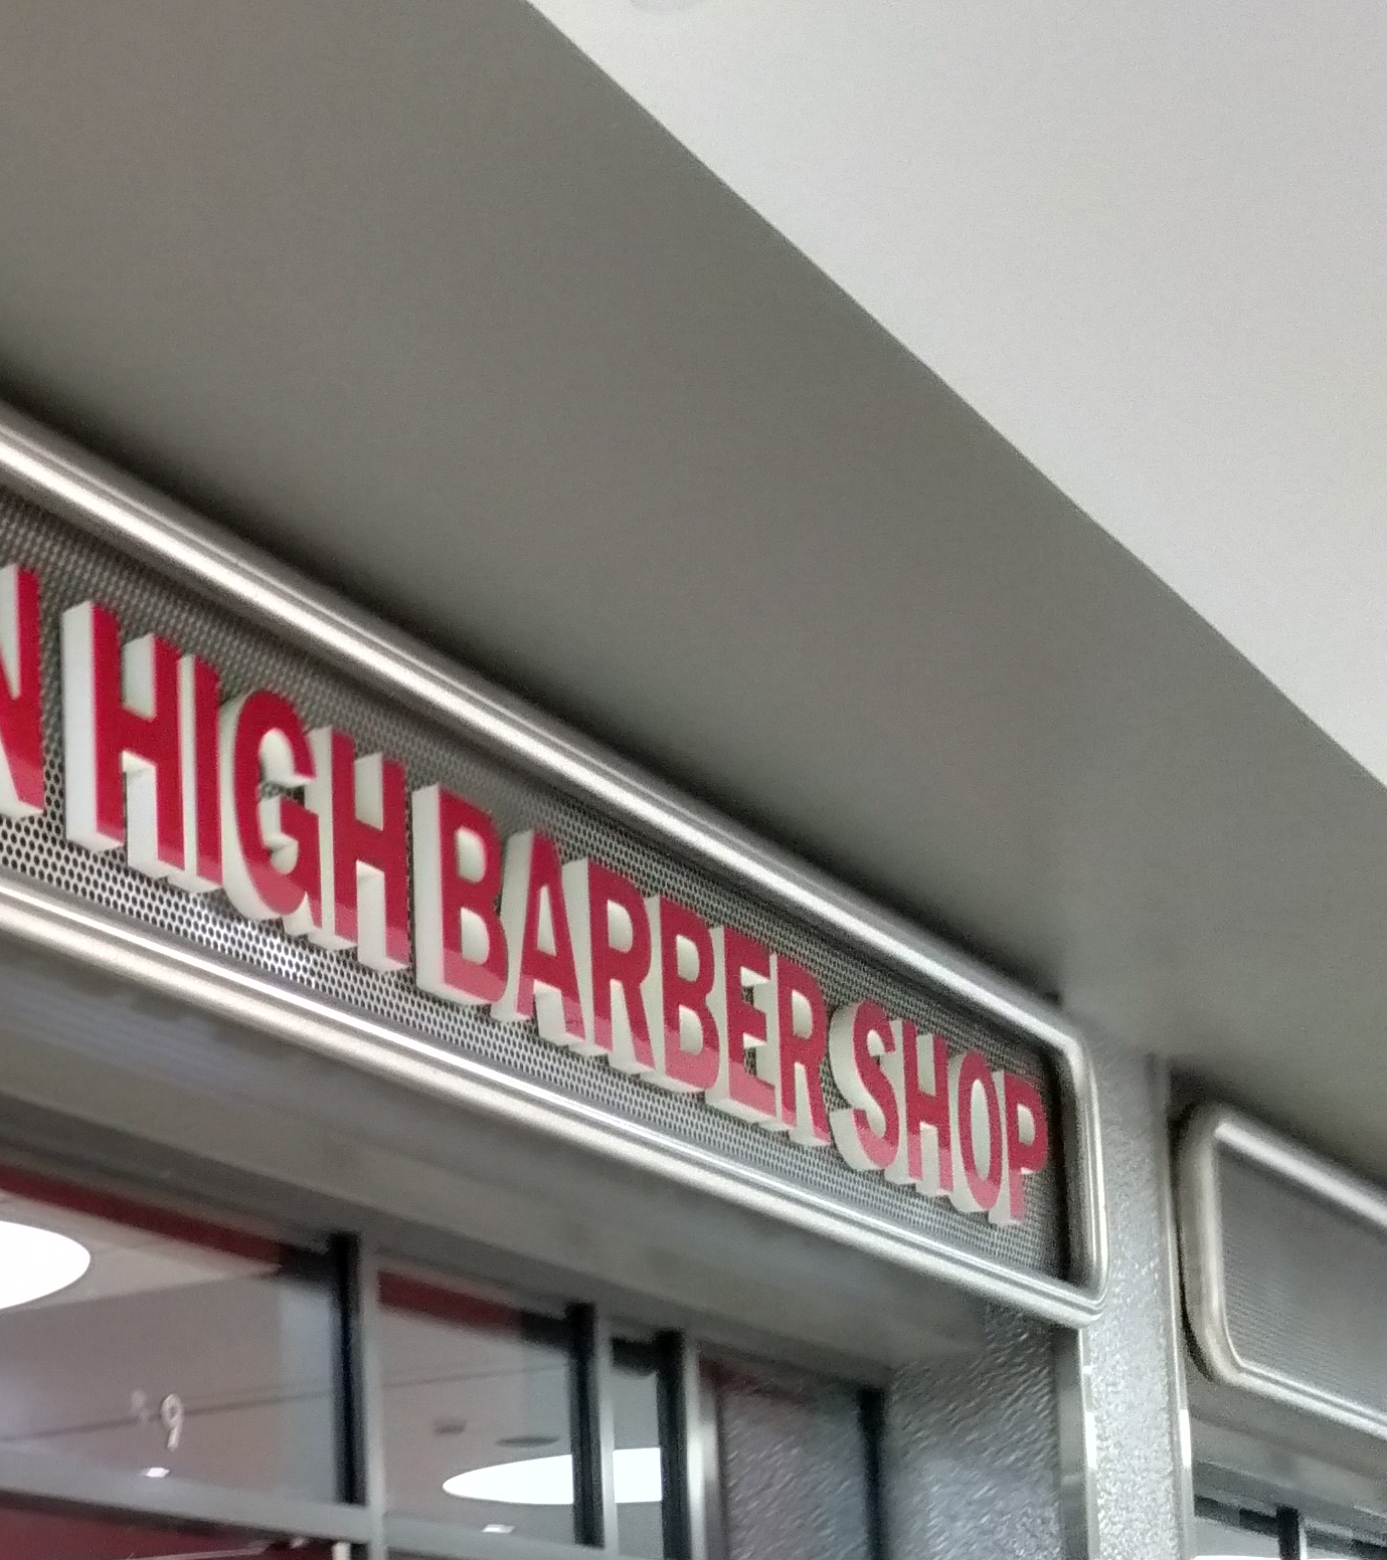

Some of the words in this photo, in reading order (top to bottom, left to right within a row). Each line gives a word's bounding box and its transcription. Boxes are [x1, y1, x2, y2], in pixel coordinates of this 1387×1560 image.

[62, 600, 409, 974] HIGH
[412, 783, 831, 1148] BARBER
[829, 1001, 1049, 1229] SHOP
